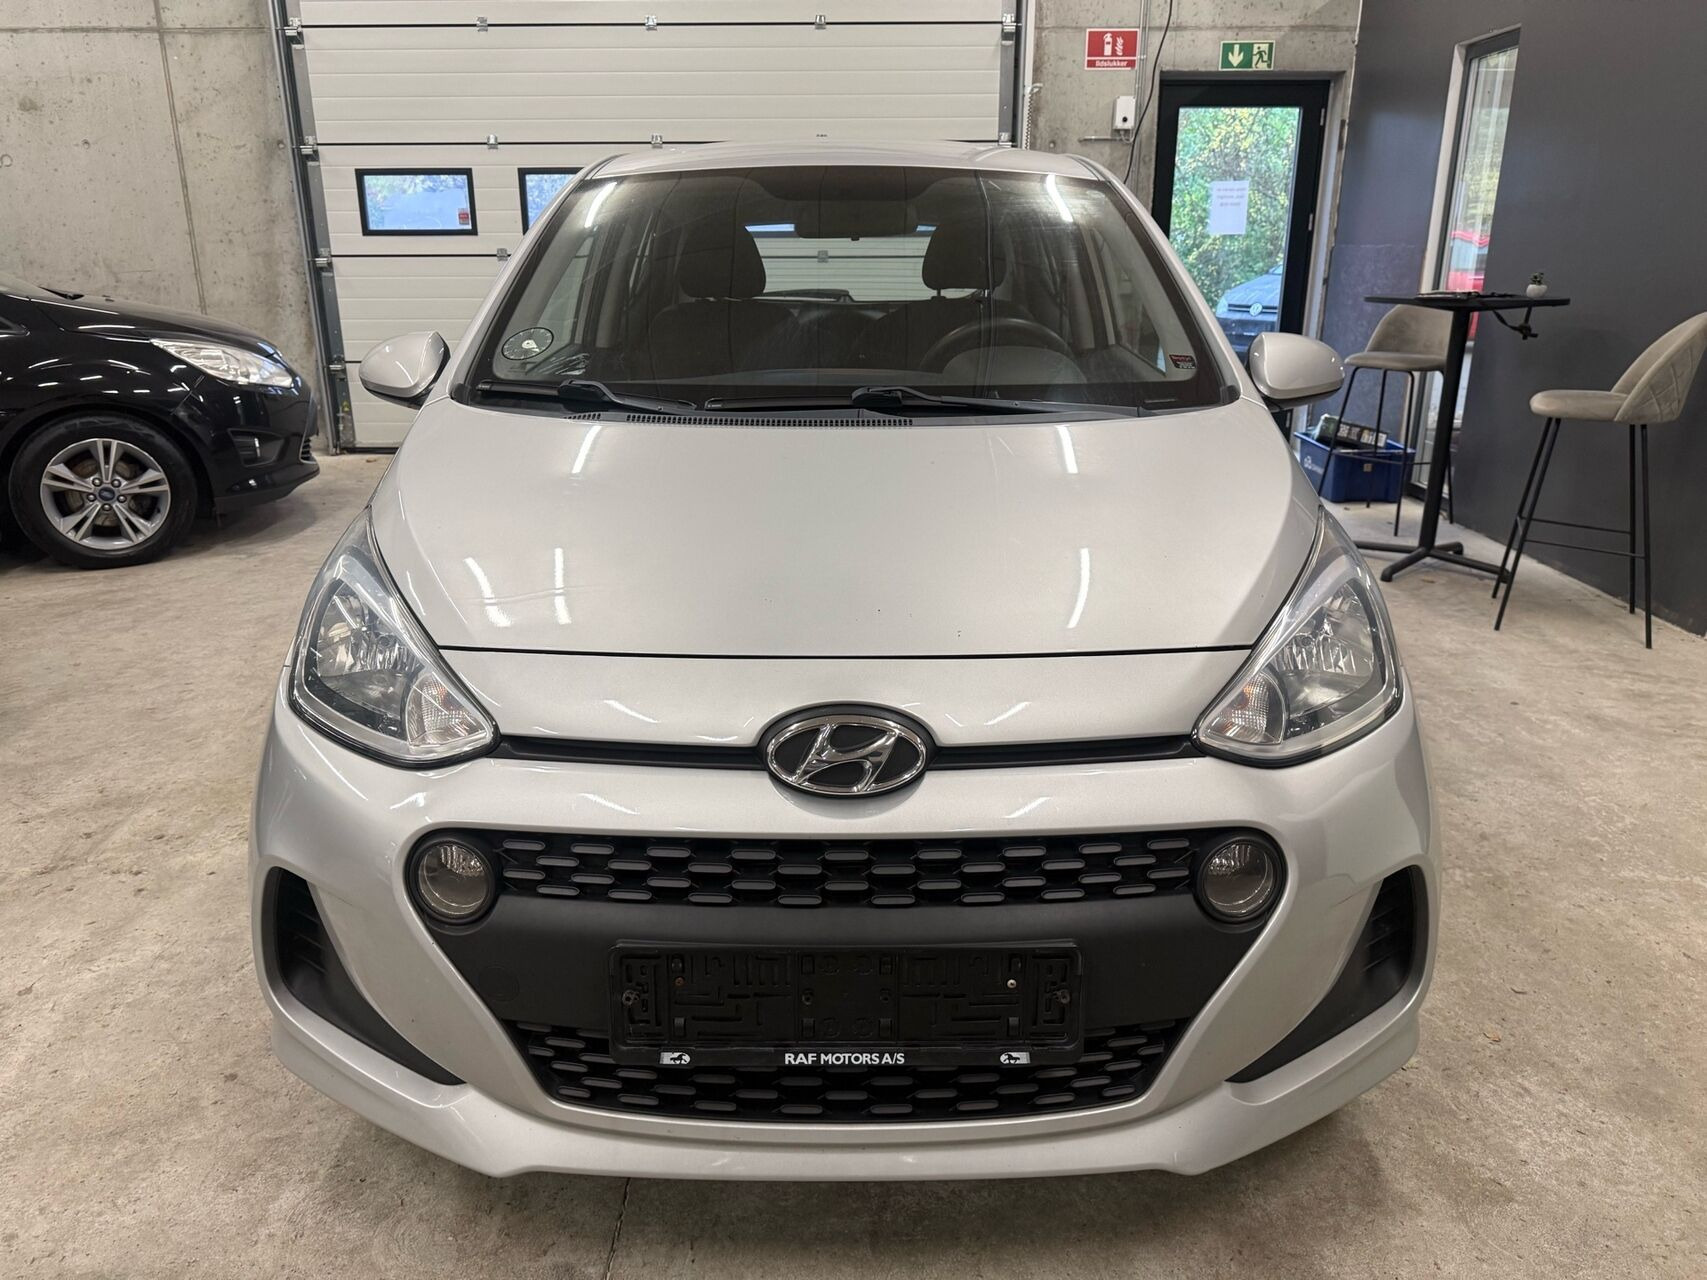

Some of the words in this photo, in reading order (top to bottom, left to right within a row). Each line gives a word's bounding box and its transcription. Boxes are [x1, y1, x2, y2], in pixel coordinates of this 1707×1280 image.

[784, 1052, 817, 1065] RAF
[820, 1052, 880, 1065] MOTORS
[881, 1052, 905, 1065] A/S
